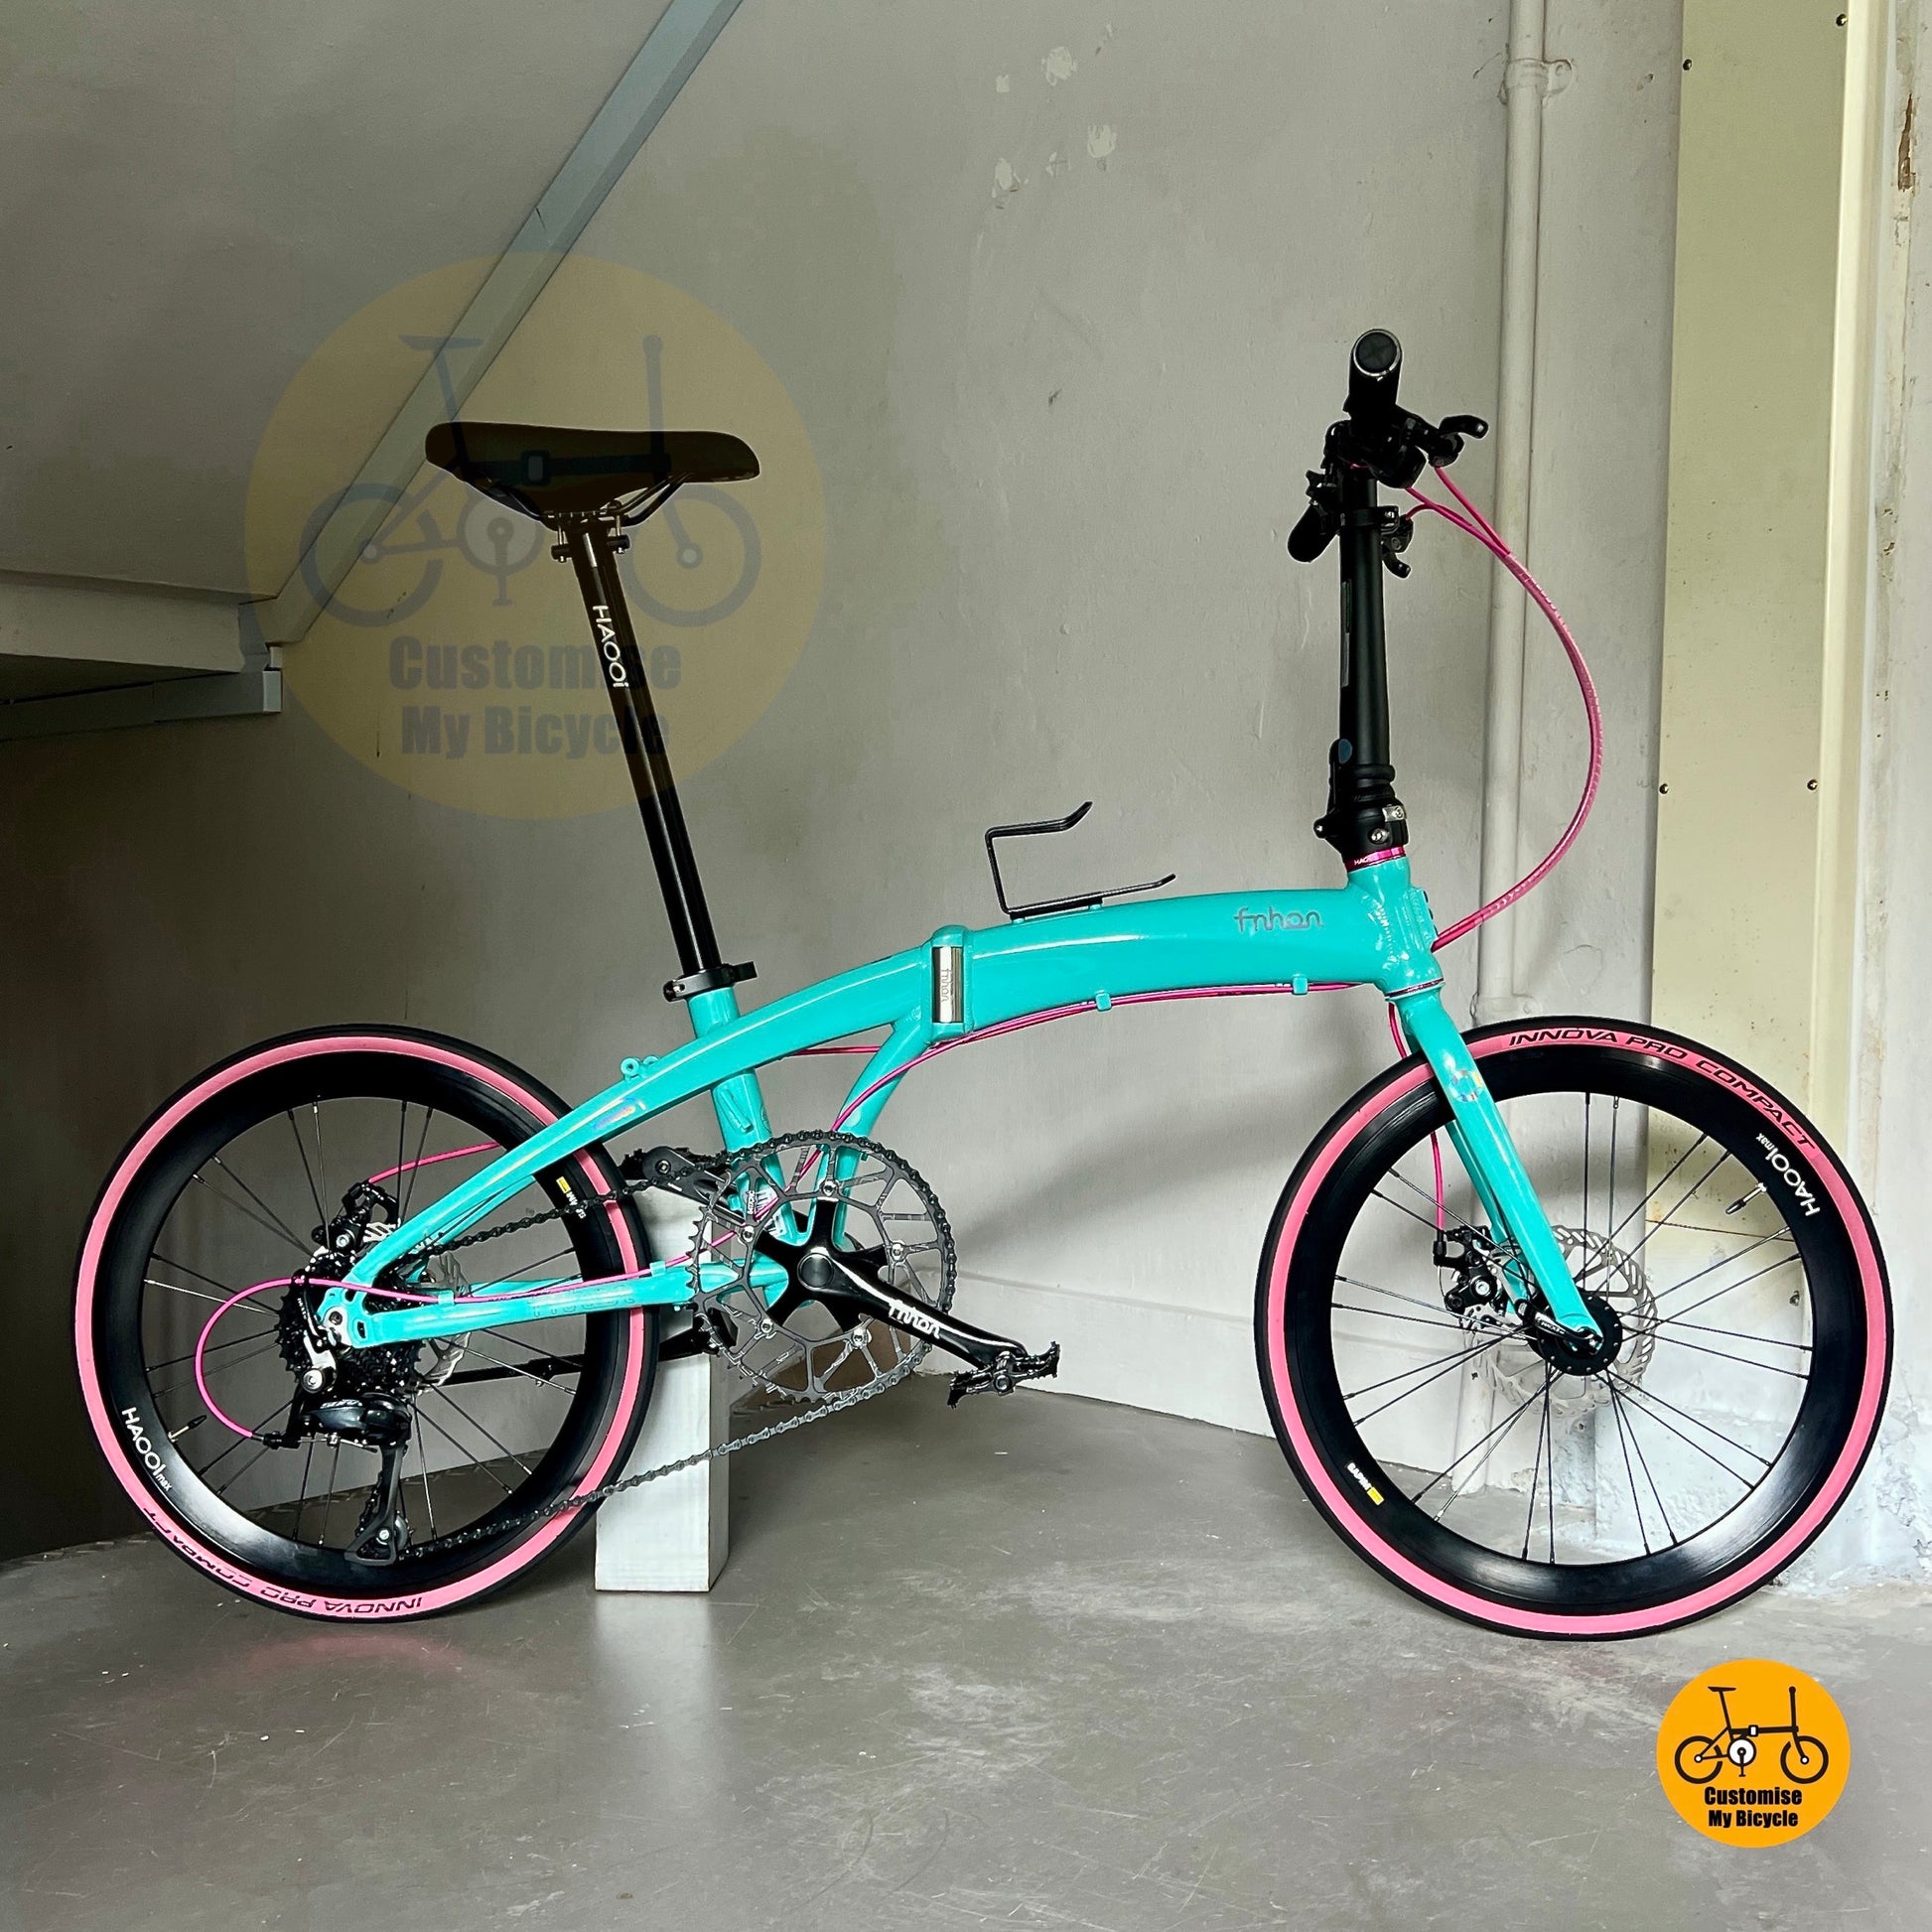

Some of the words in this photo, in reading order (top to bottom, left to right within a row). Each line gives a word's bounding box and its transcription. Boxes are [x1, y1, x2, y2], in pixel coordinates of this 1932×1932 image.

[592, 605, 629, 689] HAOOi
[1233, 905, 1323, 933] fnhon
[1509, 1029, 1617, 1046] INNOVA
[1624, 1035, 1689, 1060] PRO
[1695, 1058, 1816, 1150] COMPACT
[260, 1586, 317, 1609] PRO
[324, 1596, 423, 1614] INNOVA
